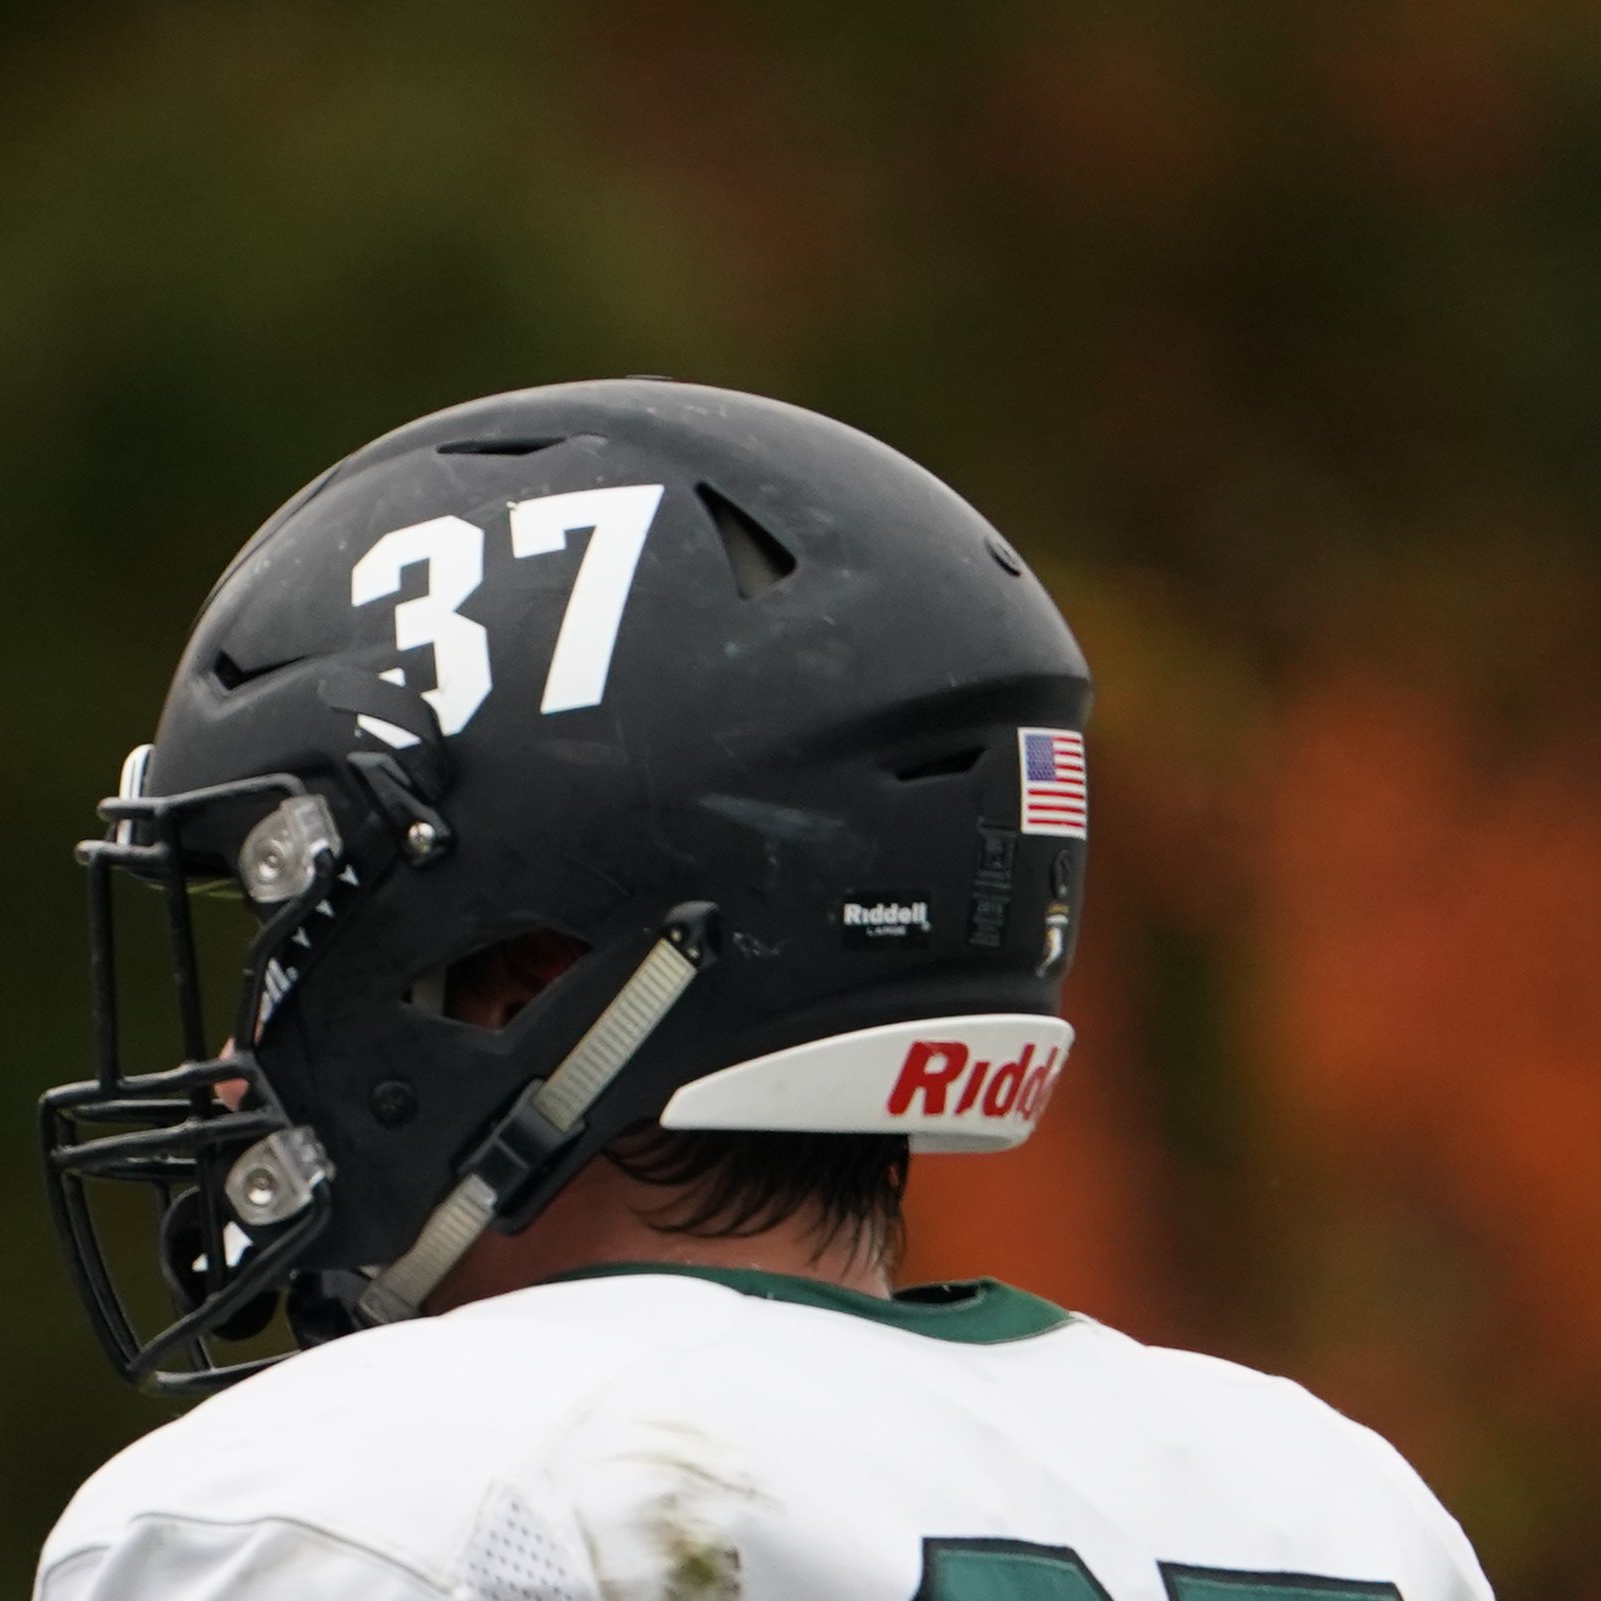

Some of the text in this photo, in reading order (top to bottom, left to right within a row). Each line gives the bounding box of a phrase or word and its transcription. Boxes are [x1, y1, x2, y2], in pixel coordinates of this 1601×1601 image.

[351, 484, 665, 749] 37
[843, 902, 928, 925] Riddell
[887, 1041, 1059, 1119] Ridd
